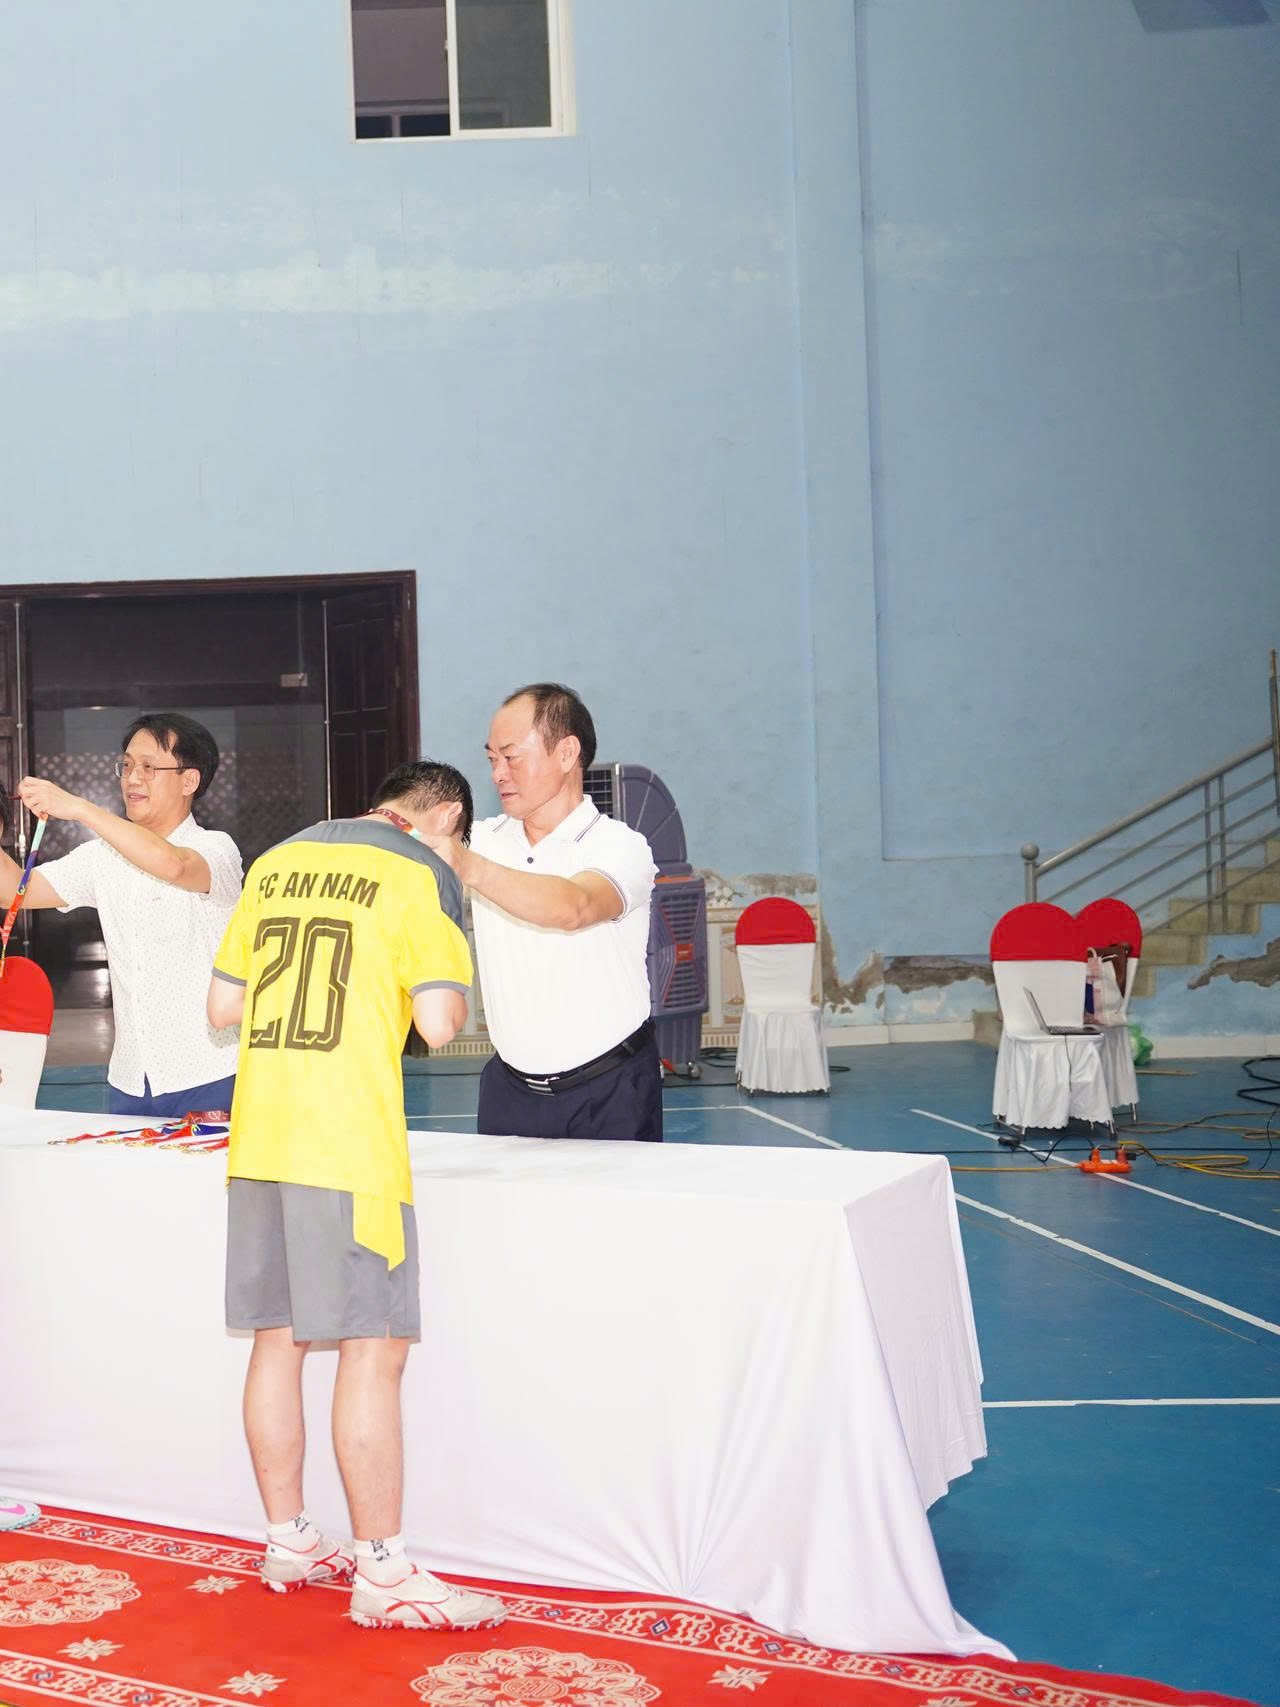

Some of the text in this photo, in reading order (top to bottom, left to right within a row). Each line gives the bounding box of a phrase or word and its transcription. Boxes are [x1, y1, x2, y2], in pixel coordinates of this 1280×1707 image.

[282, 871, 319, 898] AN
[319, 872, 381, 909] NAM
[248, 916, 354, 1053] 20
